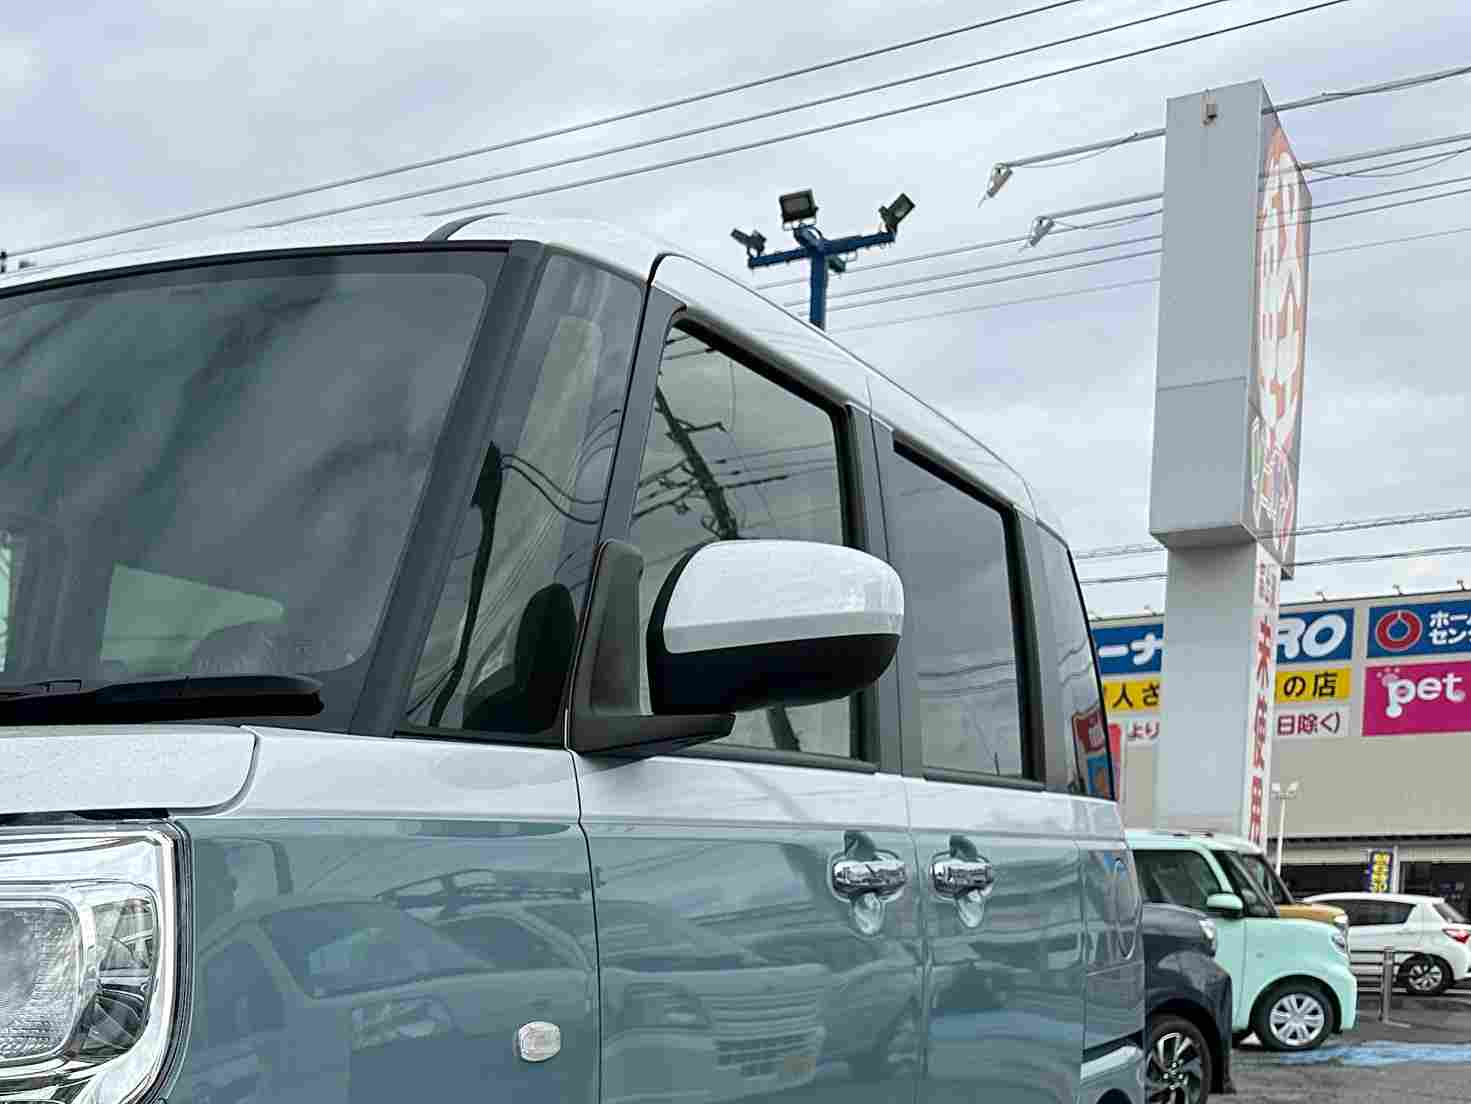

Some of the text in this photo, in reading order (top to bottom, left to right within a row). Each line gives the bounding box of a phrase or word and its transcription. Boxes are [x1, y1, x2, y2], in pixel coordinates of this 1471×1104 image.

[1429, 611, 1471, 628] ホー
[1429, 629, 1471, 645] セン
[1283, 672, 1338, 697] の店
[1382, 672, 1466, 718] pet
